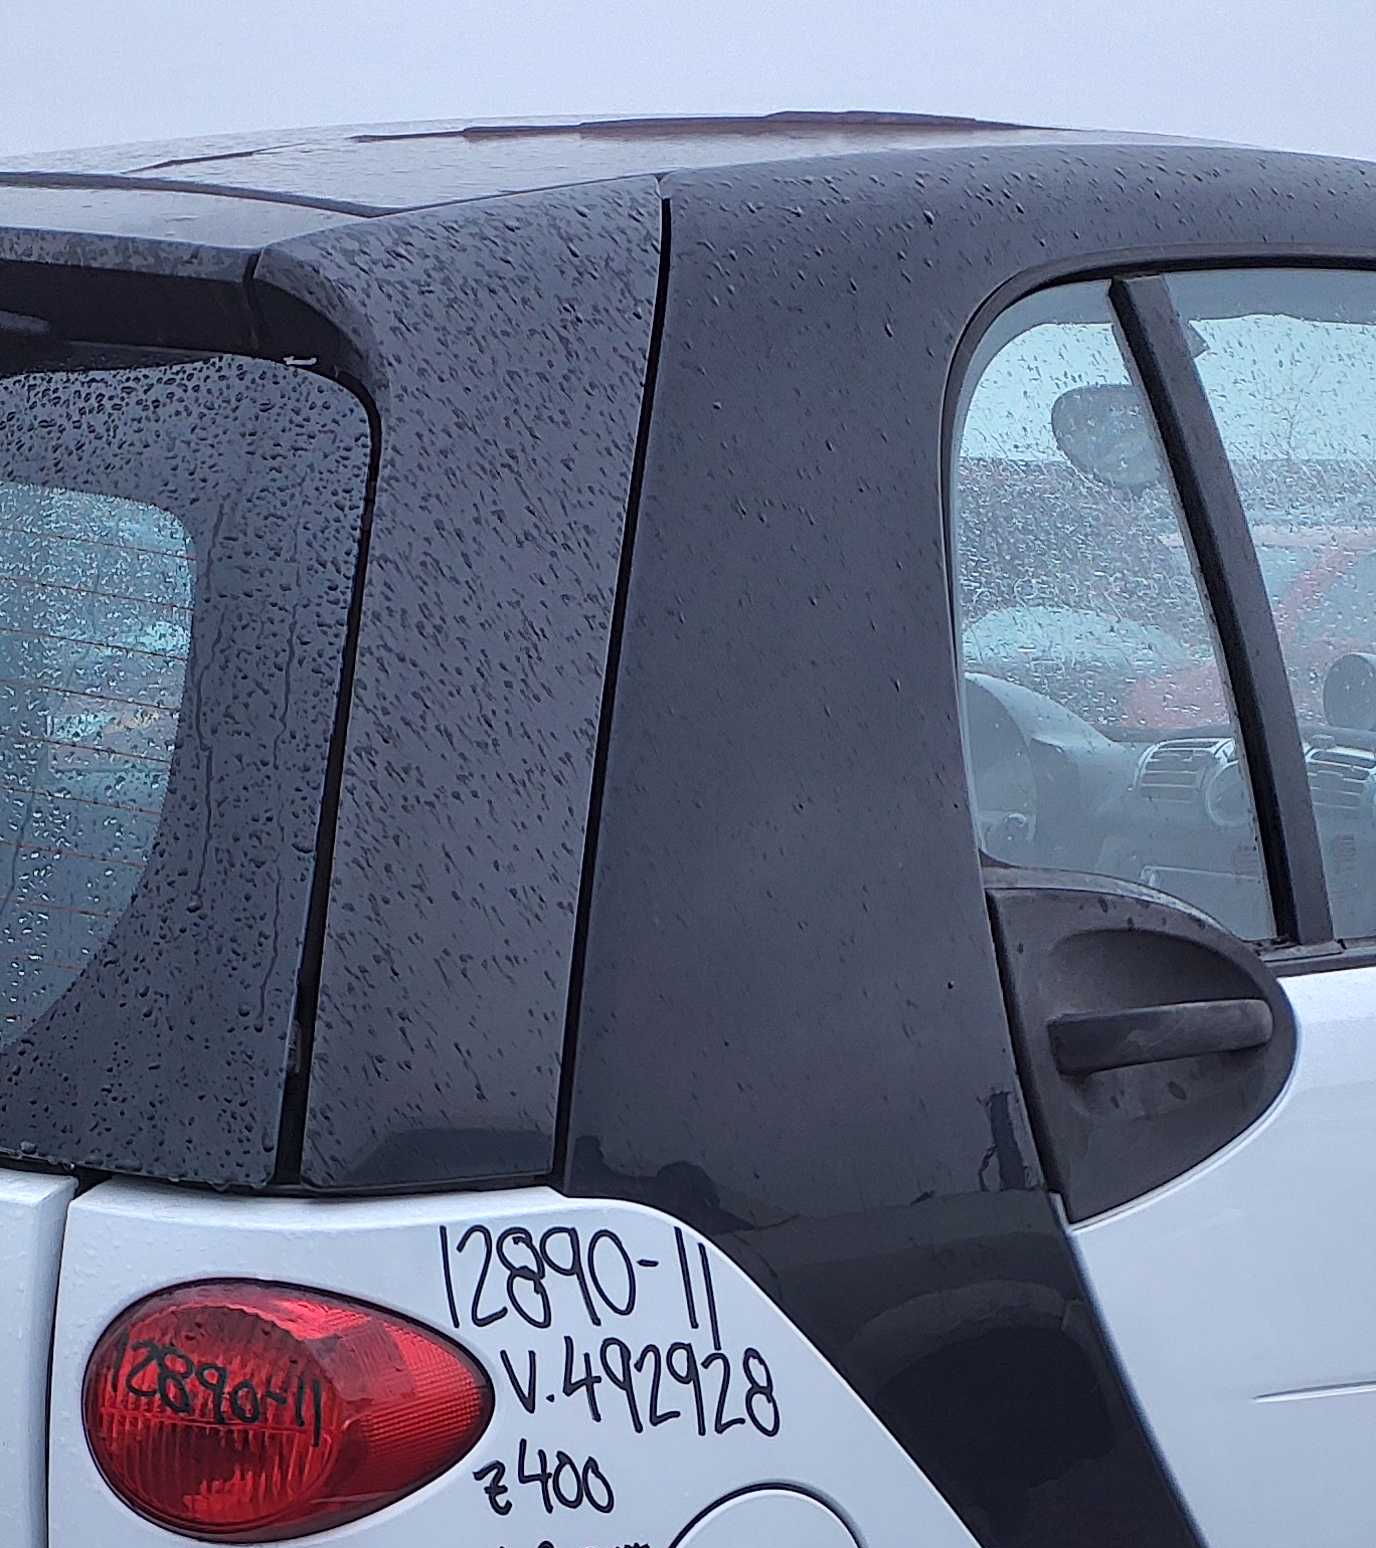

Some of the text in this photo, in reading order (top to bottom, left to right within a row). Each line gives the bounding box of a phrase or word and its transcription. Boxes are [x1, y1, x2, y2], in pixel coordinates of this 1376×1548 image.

[438, 1224, 722, 1351] 12890-11
[111, 1333, 323, 1448] 12890-11
[499, 1335, 781, 1437] V.492928
